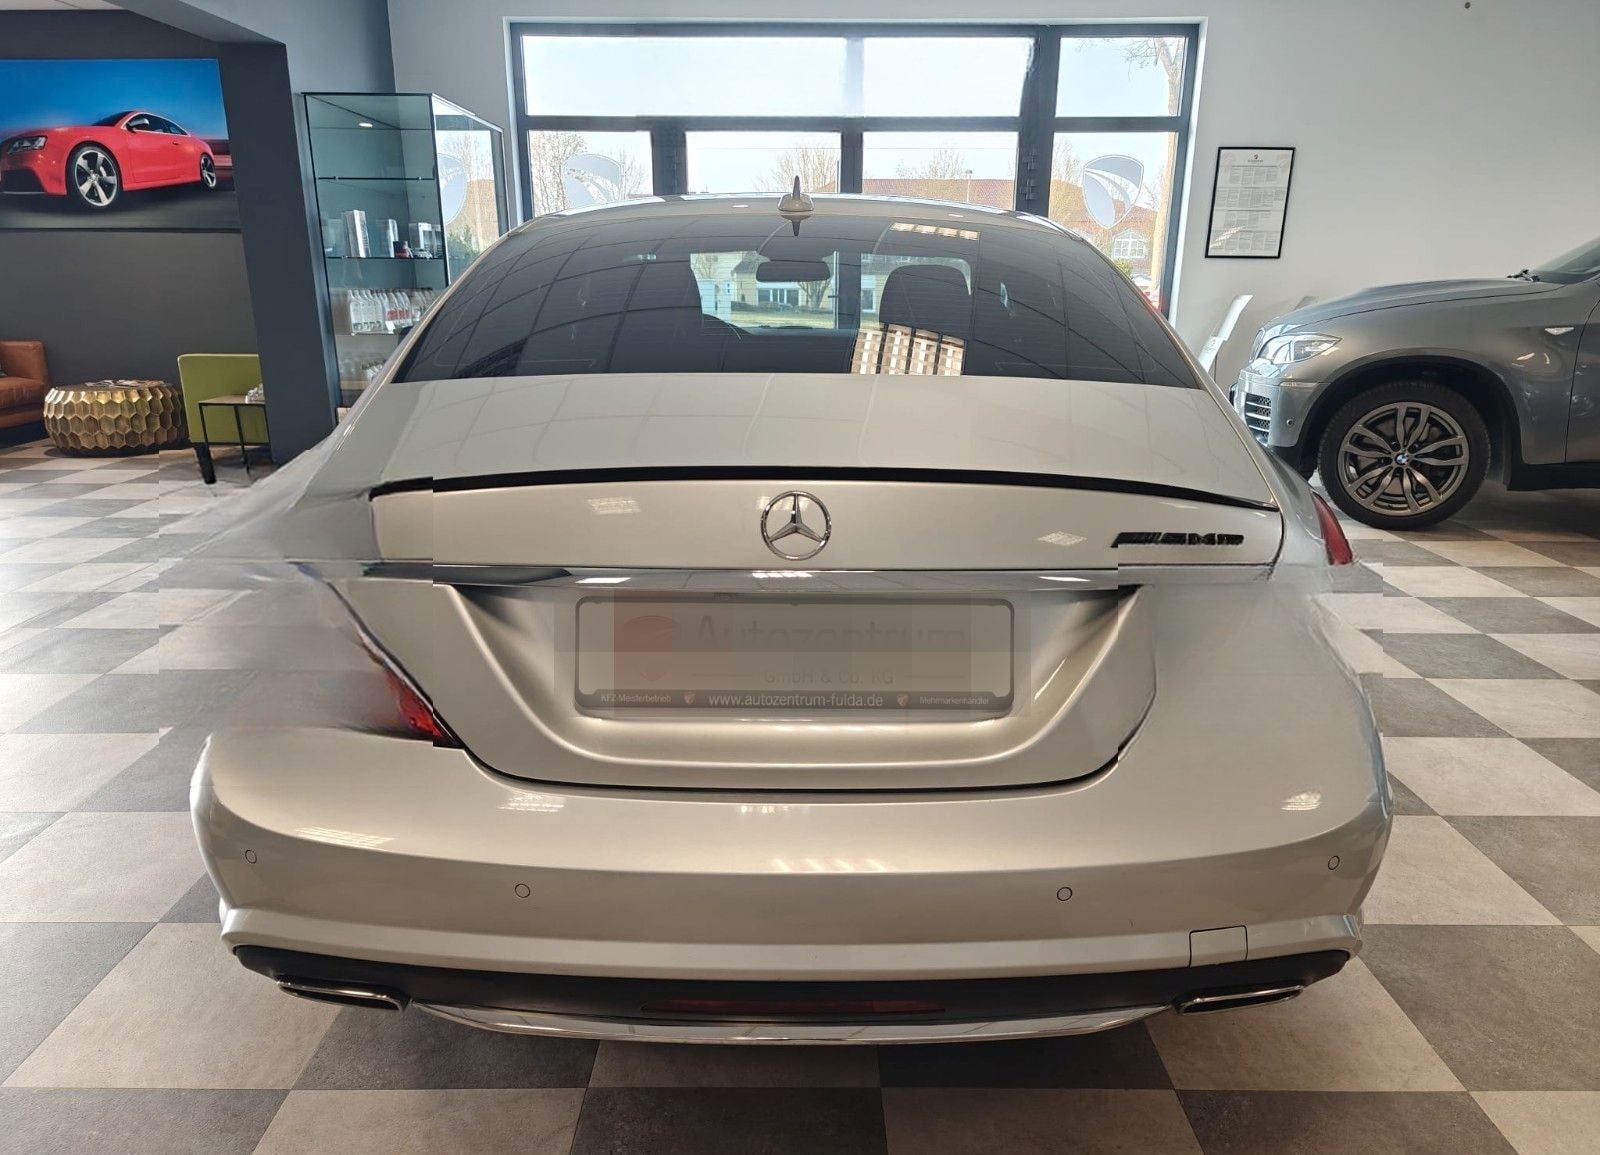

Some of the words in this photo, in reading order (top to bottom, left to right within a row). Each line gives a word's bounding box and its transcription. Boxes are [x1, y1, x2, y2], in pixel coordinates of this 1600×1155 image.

[820, 669, 833, 684] &
[871, 669, 895, 684] KG
[708, 693, 883, 707] www.autozentrum-fulda.de
